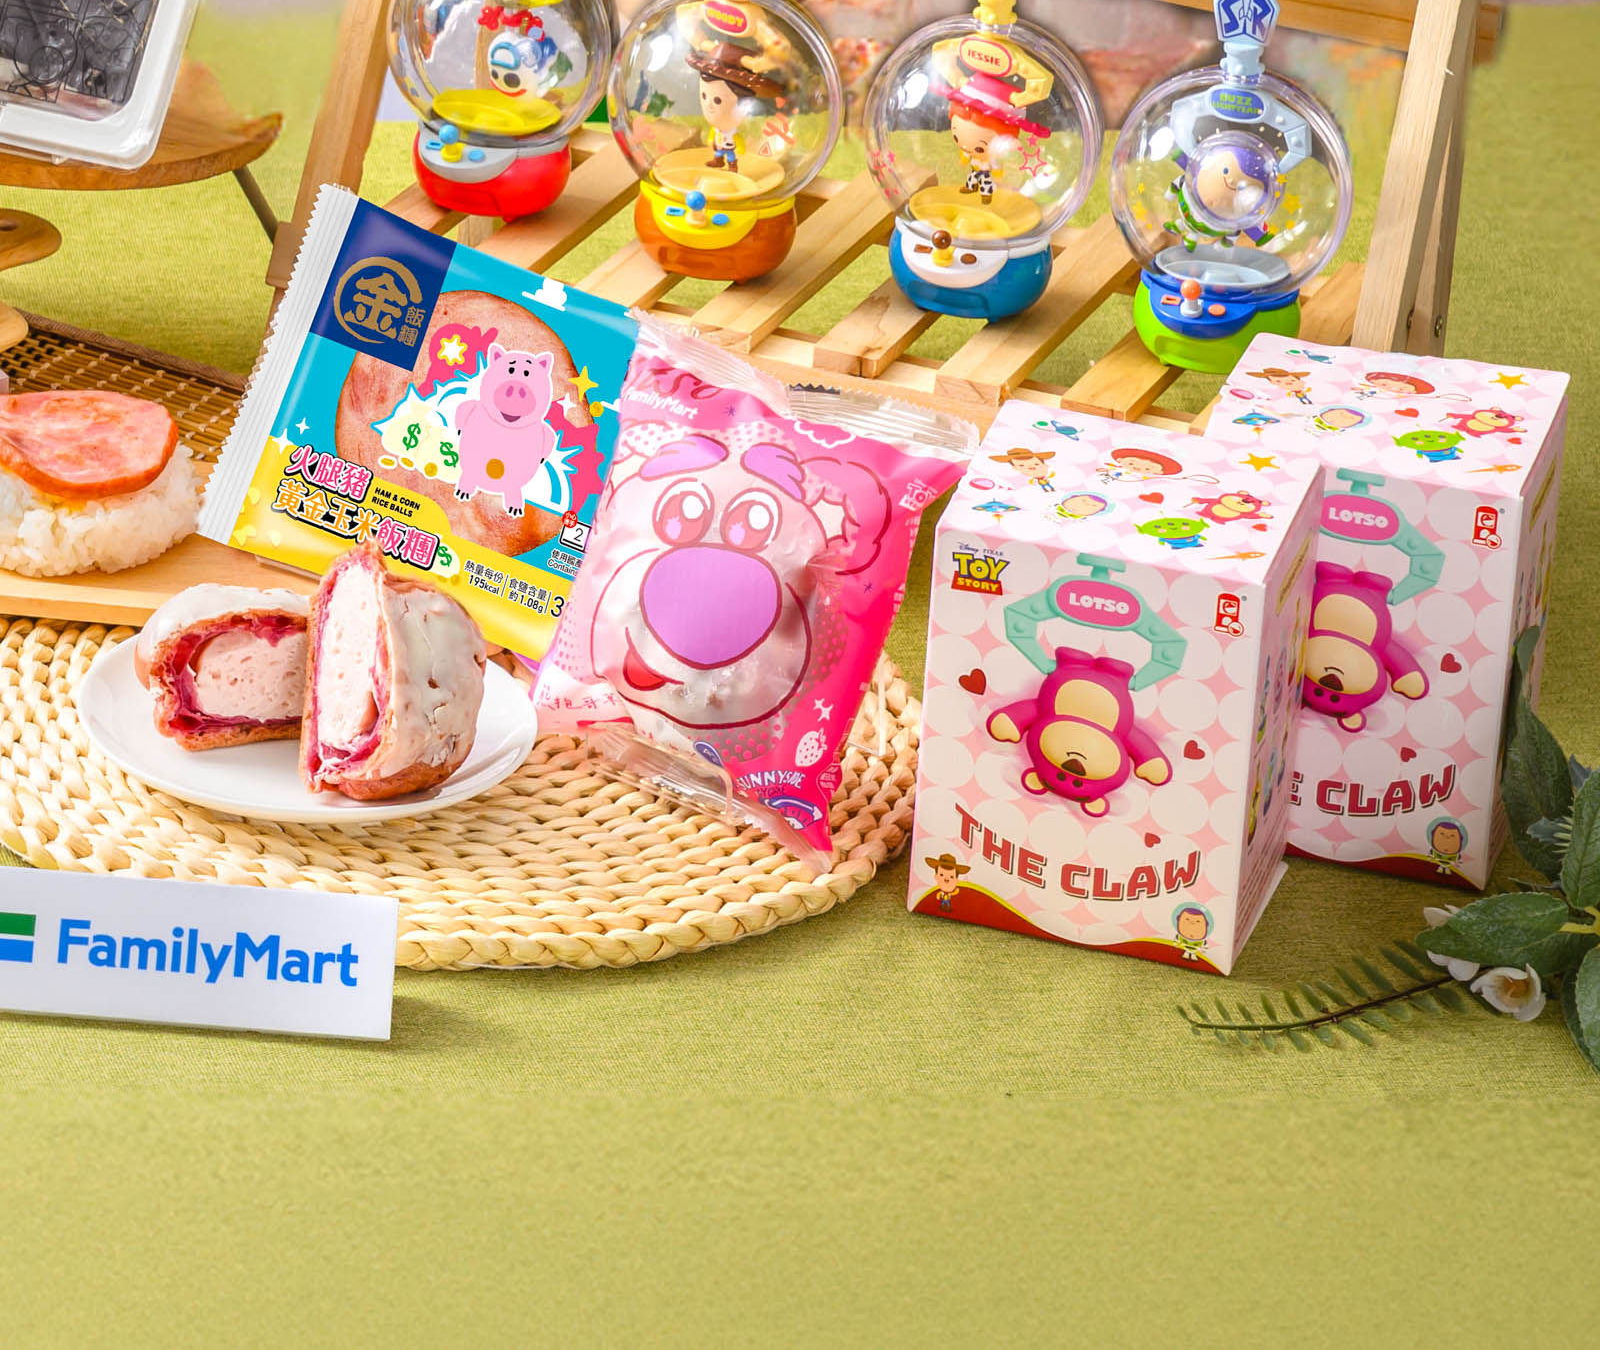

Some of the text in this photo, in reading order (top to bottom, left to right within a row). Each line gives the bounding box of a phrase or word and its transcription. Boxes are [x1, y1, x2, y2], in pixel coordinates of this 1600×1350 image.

[343, 272, 408, 340] 金
[399, 305, 426, 347] 飯糰
[285, 443, 373, 501] 火腿豬
[371, 496, 413, 518] RICE BALLS
[374, 487, 421, 511] HAM & CORN
[272, 479, 440, 569] 黃金玉米飯糰
[1328, 506, 1390, 530] LOTSO
[574, 527, 584, 542] 2
[464, 559, 505, 584] 熱量每份
[952, 551, 1010, 582] TOY
[469, 574, 500, 595] 195kcal
[508, 577, 548, 601] 食鹽含量
[956, 576, 1000, 593] STORY
[1068, 591, 1130, 615] LOTSO
[1315, 763, 1457, 817] CLAW
[955, 803, 1201, 901] THE CLAW
[57, 918, 360, 987] FamilyMart
